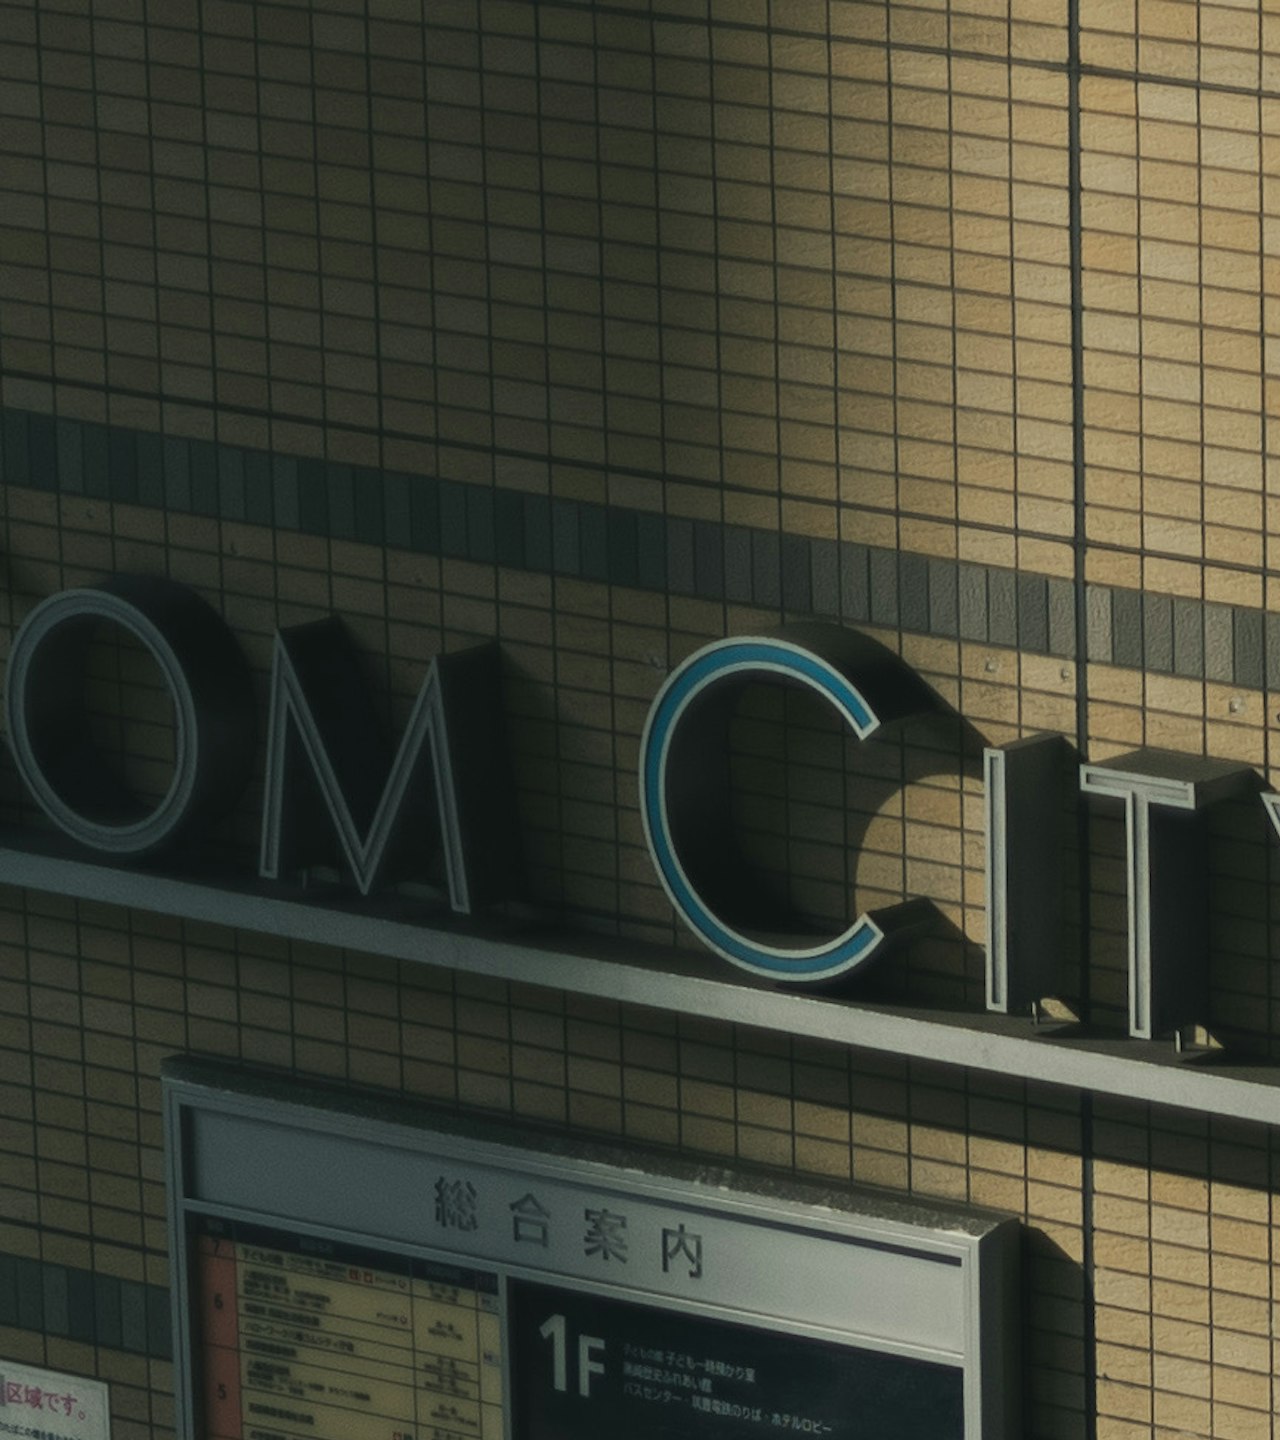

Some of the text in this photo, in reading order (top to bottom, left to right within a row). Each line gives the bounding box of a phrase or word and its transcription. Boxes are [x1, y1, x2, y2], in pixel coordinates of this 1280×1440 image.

[5, 588, 472, 914] OM
[433, 1175, 705, 1280] 総合案内
[538, 1313, 607, 1398] 1F
